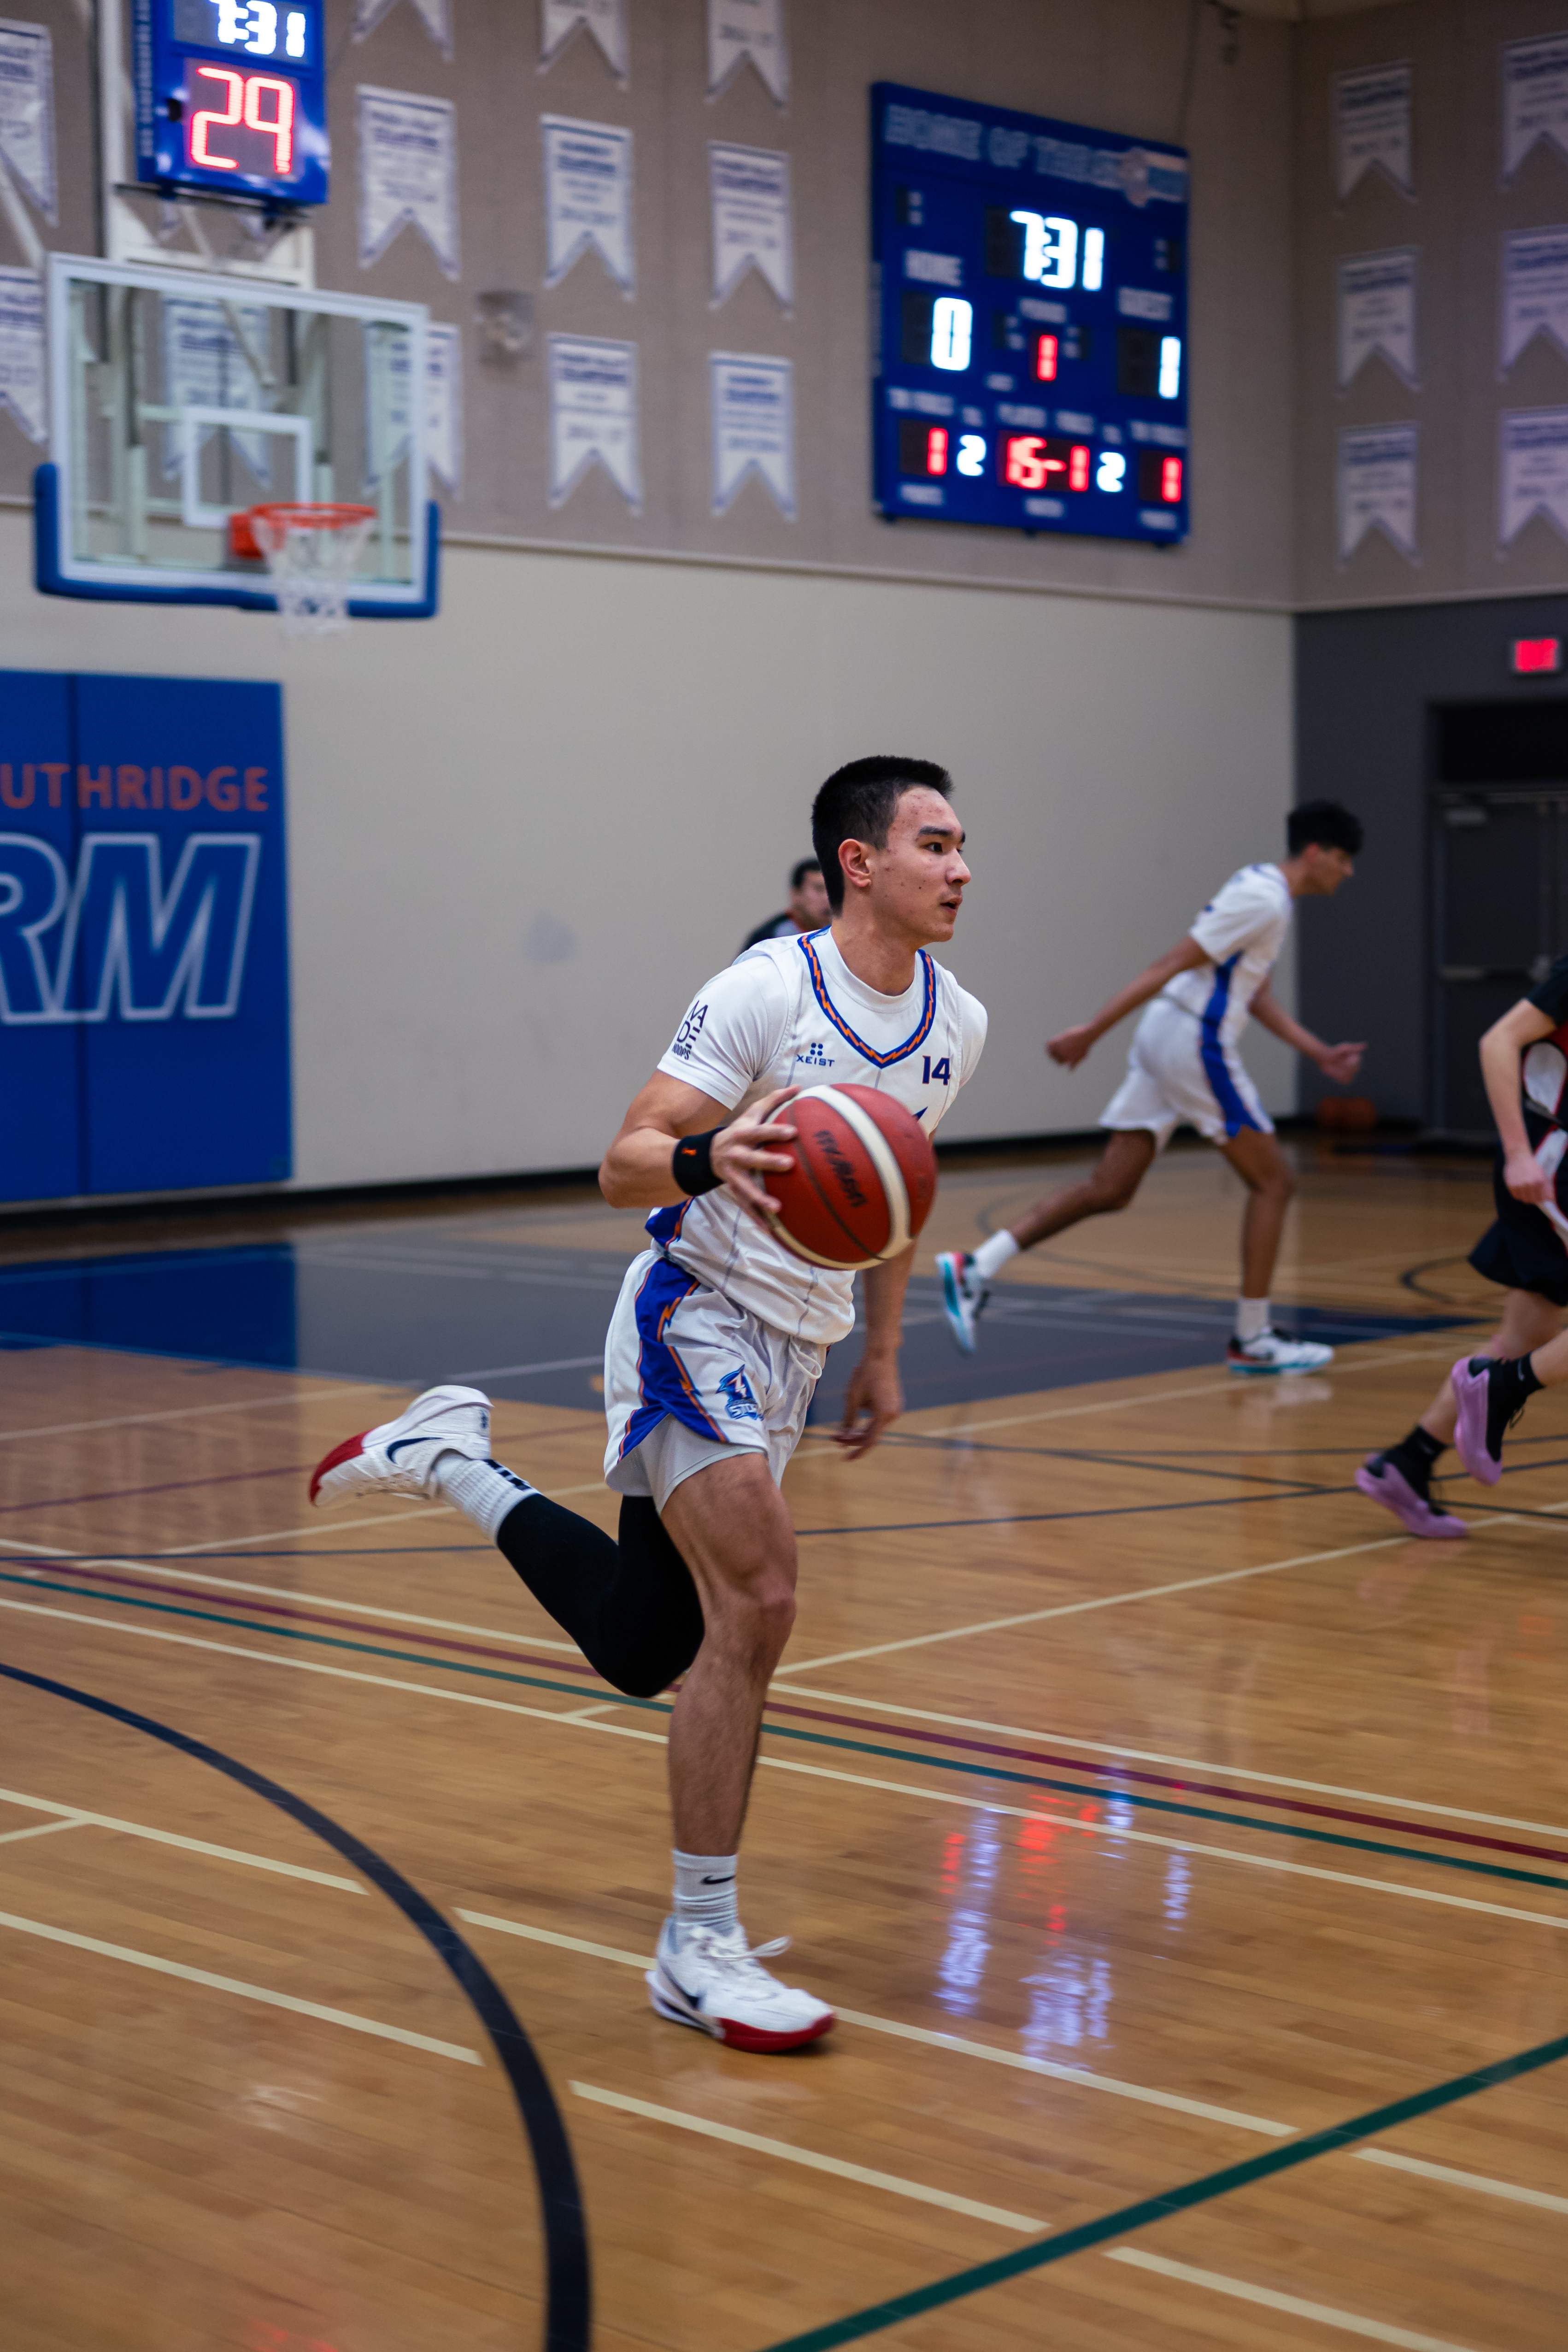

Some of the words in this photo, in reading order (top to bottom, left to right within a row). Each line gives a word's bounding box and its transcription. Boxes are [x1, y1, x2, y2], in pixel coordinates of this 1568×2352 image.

[189, 65, 295, 176] 29
[930, 297, 973, 371] 0
[1037, 335, 1057, 381] 1
[1159, 336, 1181, 399] 1
[927, 428, 948, 475] 1
[957, 435, 987, 476] 2
[1096, 452, 1126, 493] 2
[1162, 457, 1182, 502] 1
[0, 832, 261, 1024] RM
[796, 1054, 835, 1067] XEIST
[922, 1055, 951, 1086] 14
